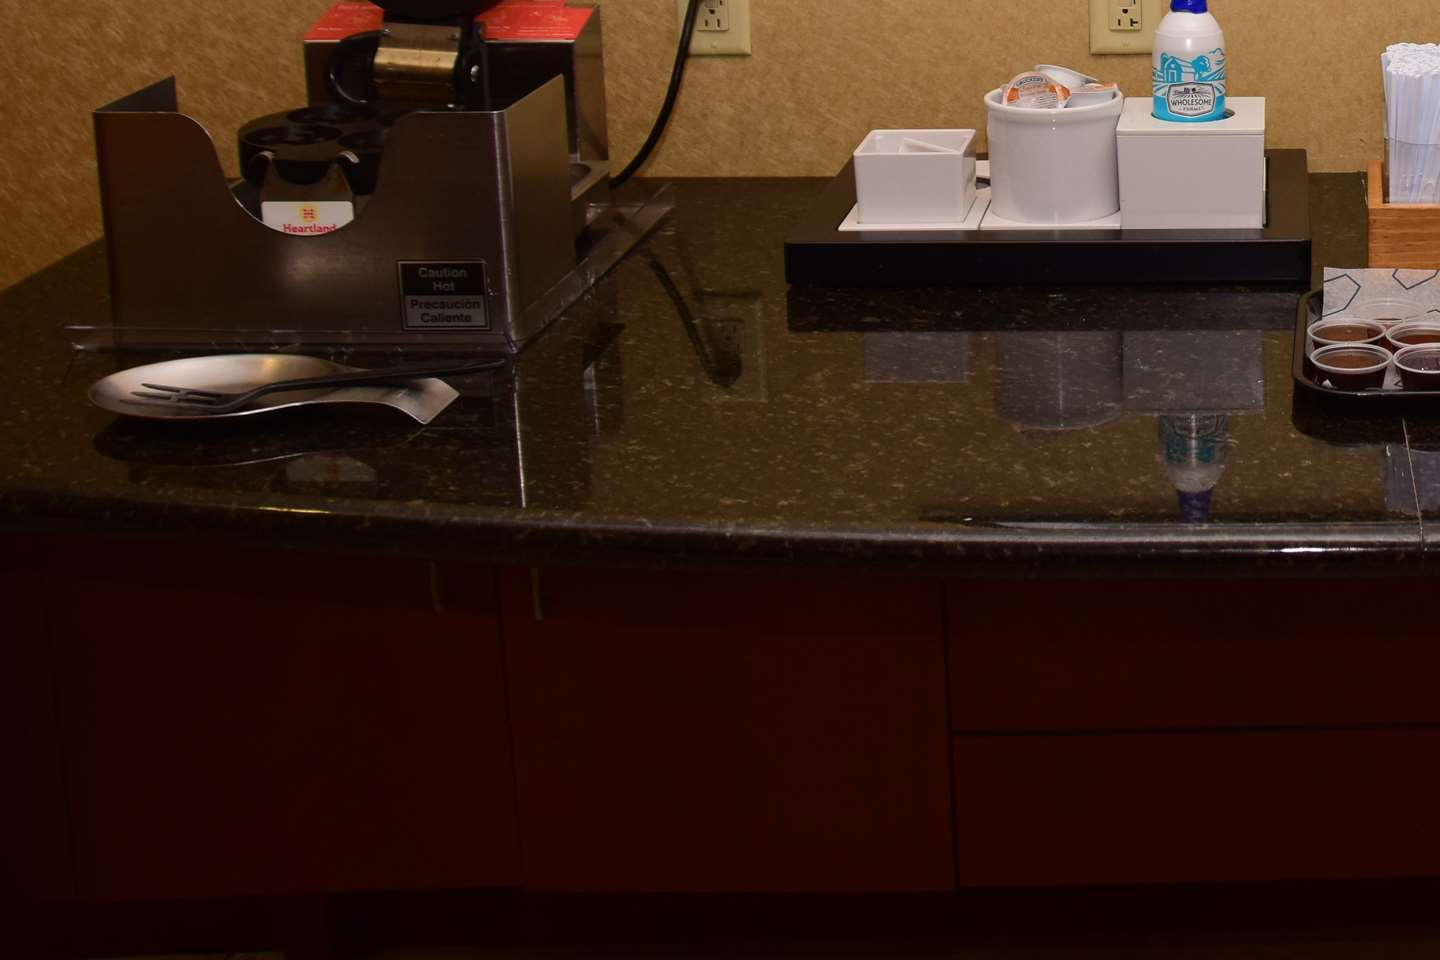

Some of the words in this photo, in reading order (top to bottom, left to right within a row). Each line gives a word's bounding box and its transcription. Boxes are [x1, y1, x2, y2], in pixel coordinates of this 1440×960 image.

[1171, 98, 1212, 106] WHOLESOME
[283, 223, 337, 234] Heartland
[418, 267, 468, 278] Caution
[432, 281, 455, 291] Hot
[420, 312, 472, 323] Caliente
